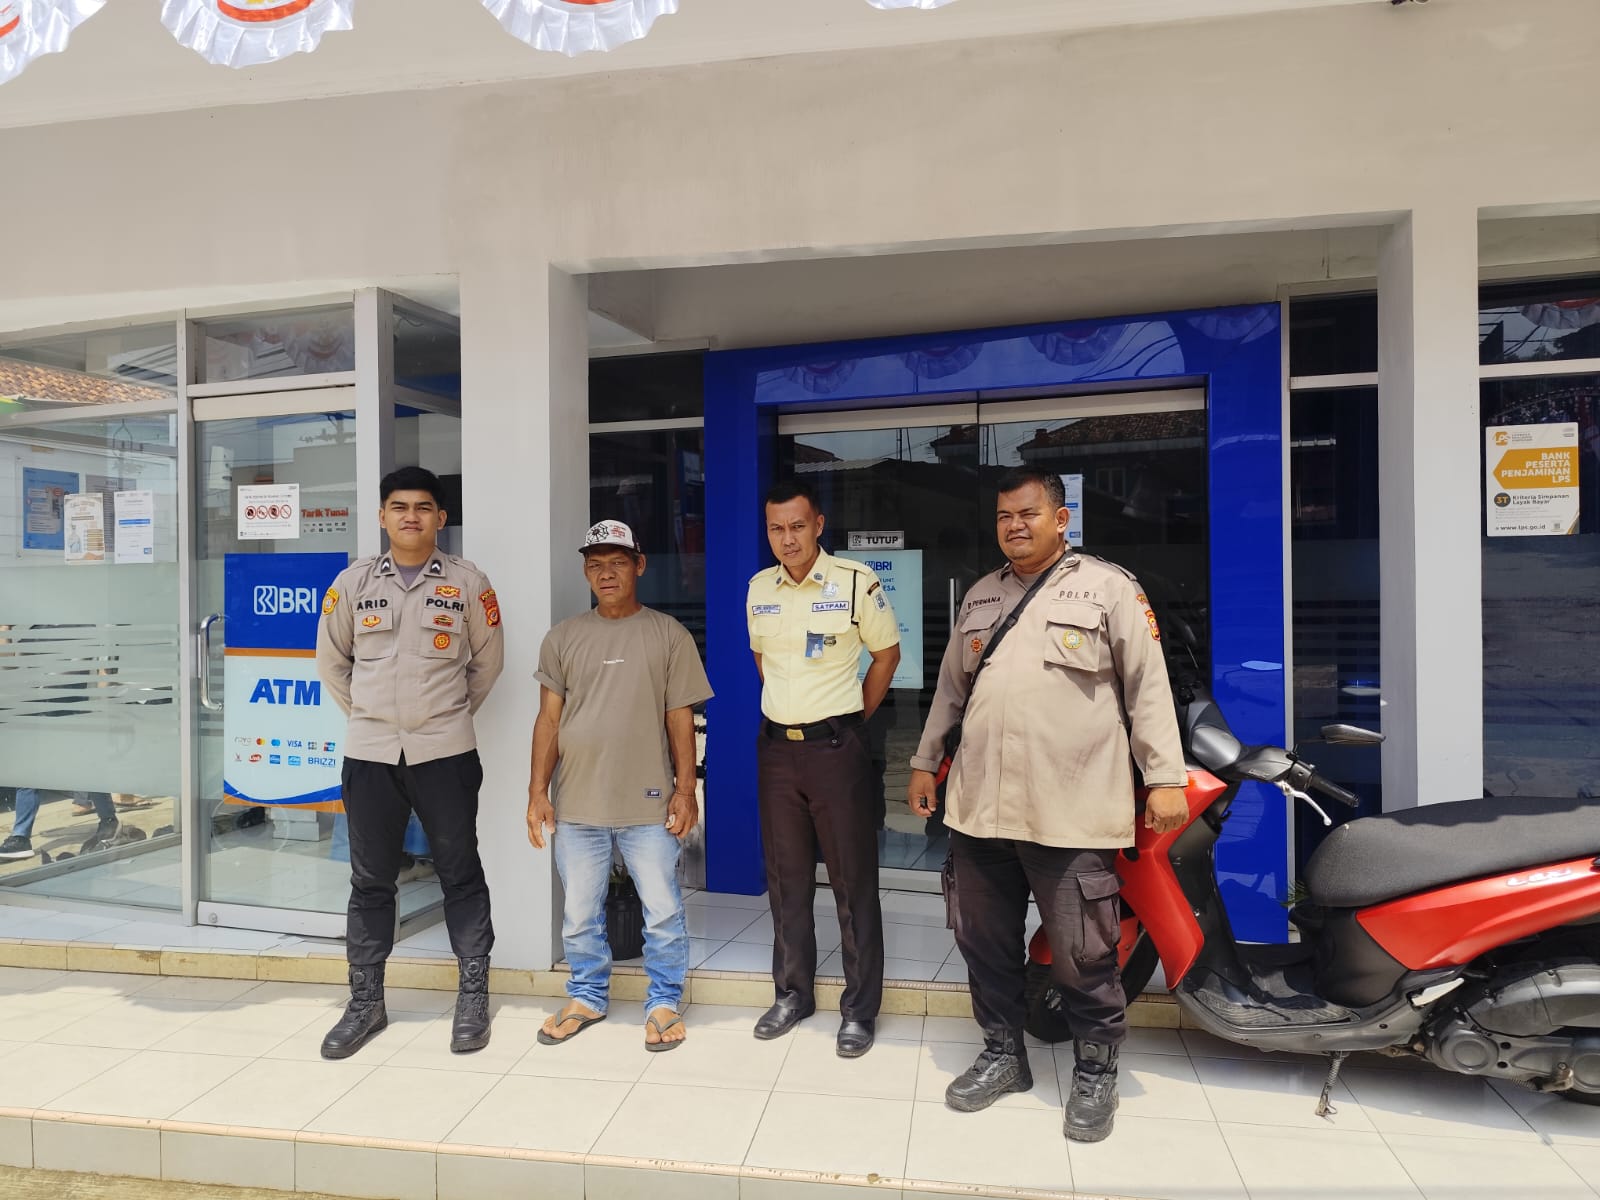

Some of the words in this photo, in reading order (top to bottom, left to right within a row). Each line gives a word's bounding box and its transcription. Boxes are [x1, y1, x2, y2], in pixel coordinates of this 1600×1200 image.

[1541, 452, 1570, 460] BANK
[1525, 460, 1571, 469] PESERTA
[1501, 468, 1571, 477] PENJAMINAN
[1552, 475, 1571, 483] LPS
[1496, 496, 1509, 504] 3T
[301, 508, 323, 518] Tarik
[325, 507, 349, 518] Tunai
[866, 535, 899, 544] TUTUP
[875, 561, 892, 571] BRI
[1059, 590, 1097, 600] POLRI
[279, 587, 317, 613] BRI
[356, 599, 388, 611] ARID
[425, 598, 465, 612] POLRI
[814, 602, 847, 611] SATPAM
[249, 678, 321, 706] ATM
[287, 740, 302, 748] VISA
[308, 757, 336, 767] BRIZZI
